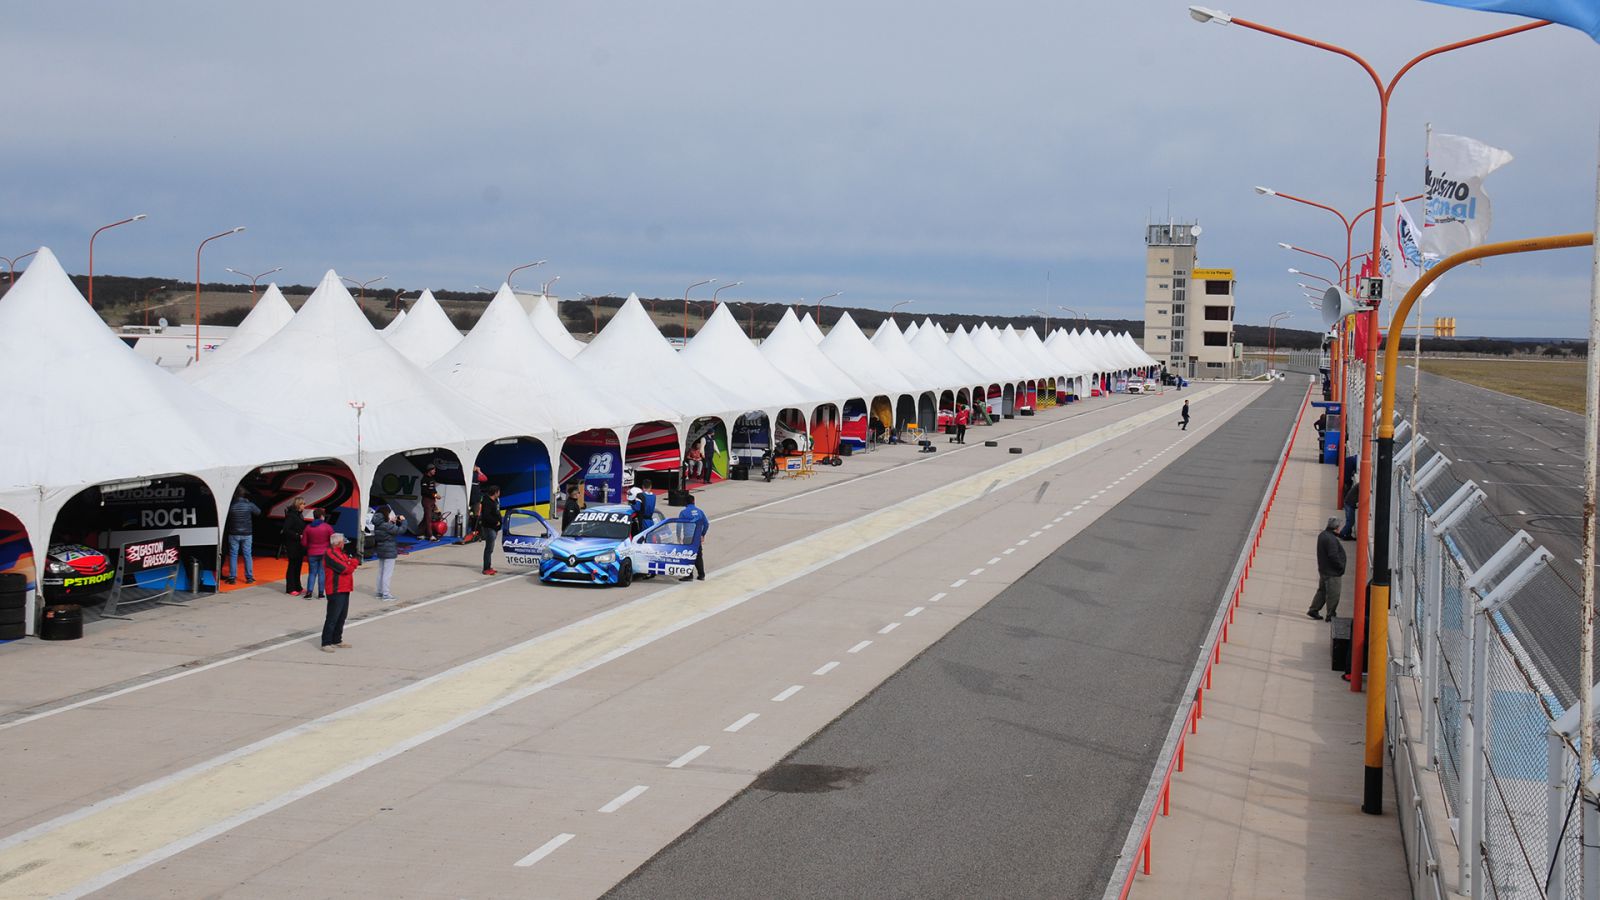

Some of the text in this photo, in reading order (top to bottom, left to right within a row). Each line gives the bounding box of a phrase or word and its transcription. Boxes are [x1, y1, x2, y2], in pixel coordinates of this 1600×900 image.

[589, 452, 614, 475] 23
[267, 472, 339, 521] 2
[141, 507, 197, 527] ROCH
[574, 512, 631, 525] FABRI S.A.
[140, 541, 164, 557] GASTON
[142, 551, 167, 568] GRASSO
